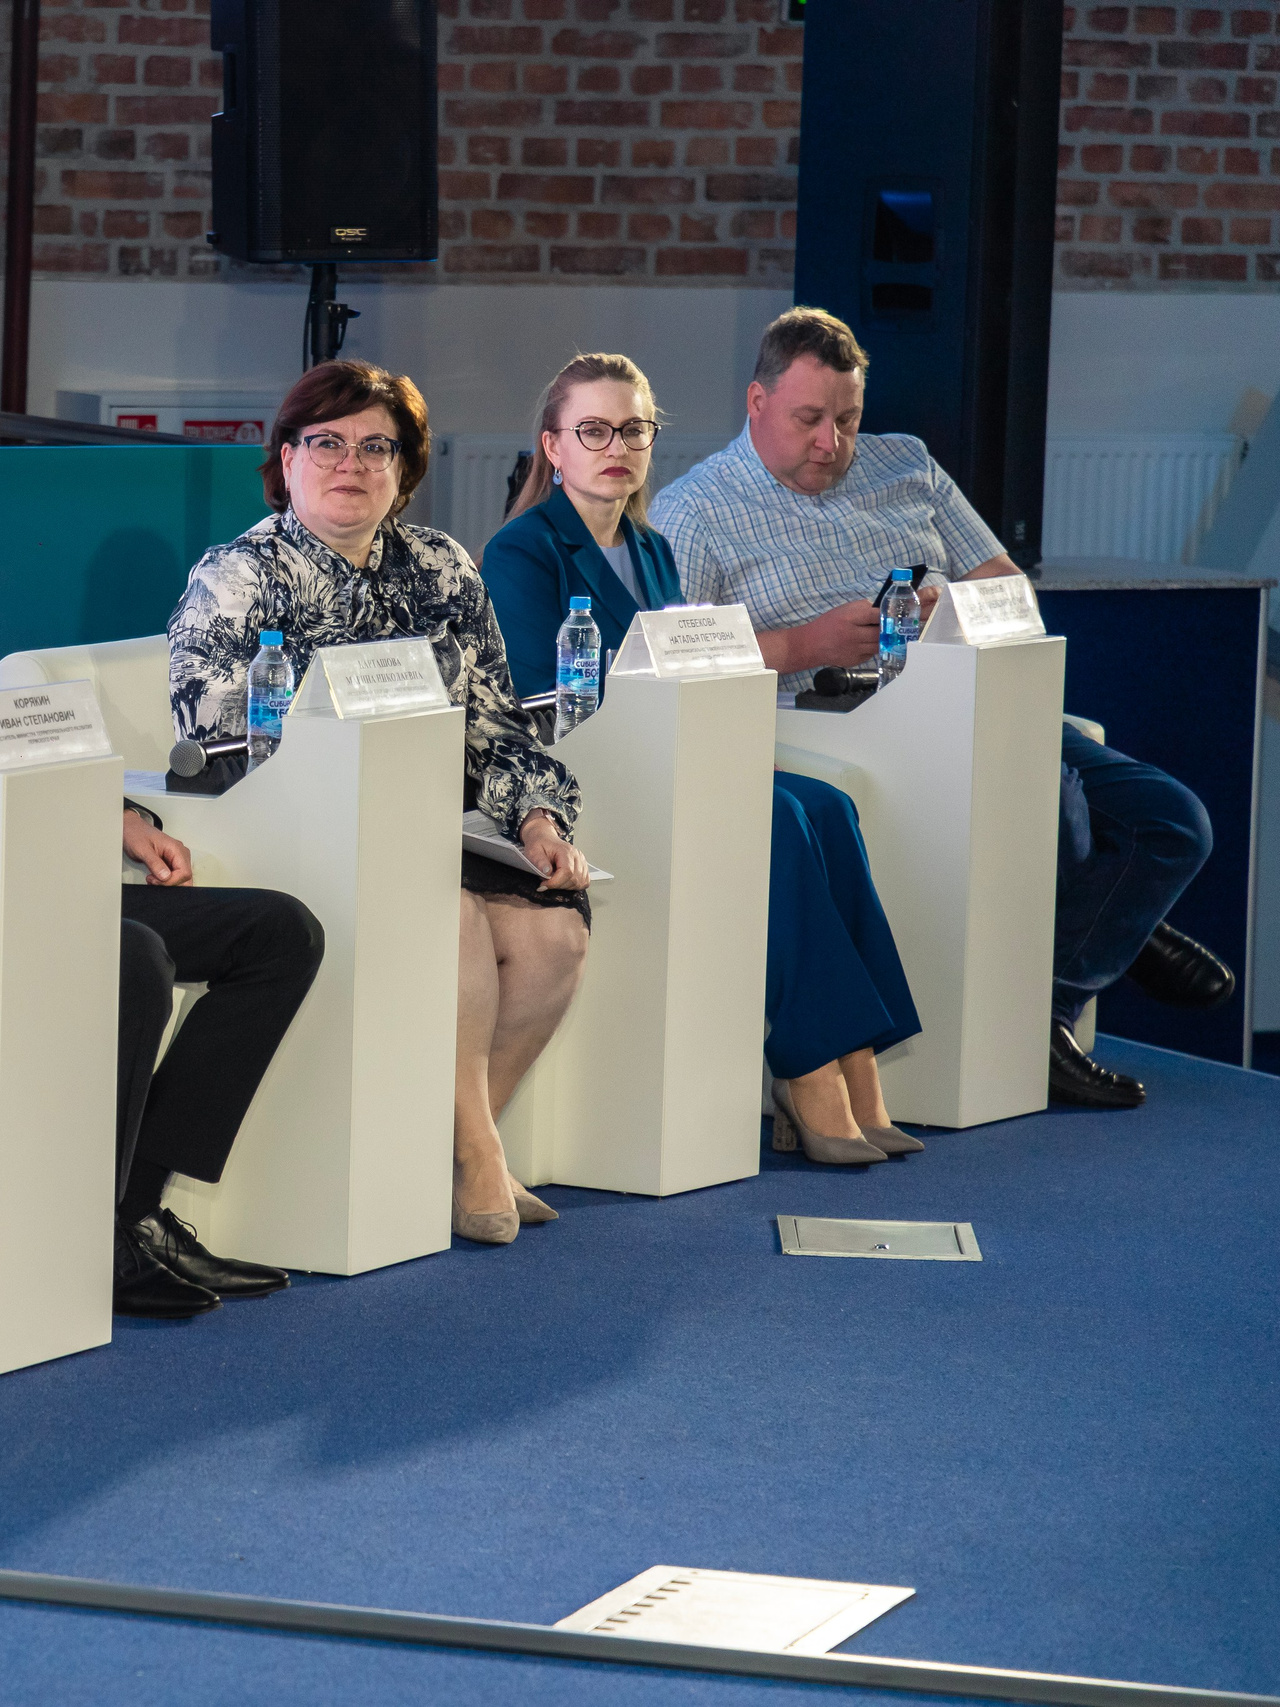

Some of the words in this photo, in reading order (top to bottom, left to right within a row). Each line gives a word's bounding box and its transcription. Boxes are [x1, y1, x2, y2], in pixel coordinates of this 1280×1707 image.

[335, 228, 367, 236] QSC
[668, 632, 701, 646] НАТАЛЬЯ
[701, 630, 736, 643] ПЕТРОВНА
[13, 695, 51, 709] КОРЯКИН
[0, 716, 23, 730] ИВАН
[23, 709, 76, 727] СТЕПАНОВИЧ
